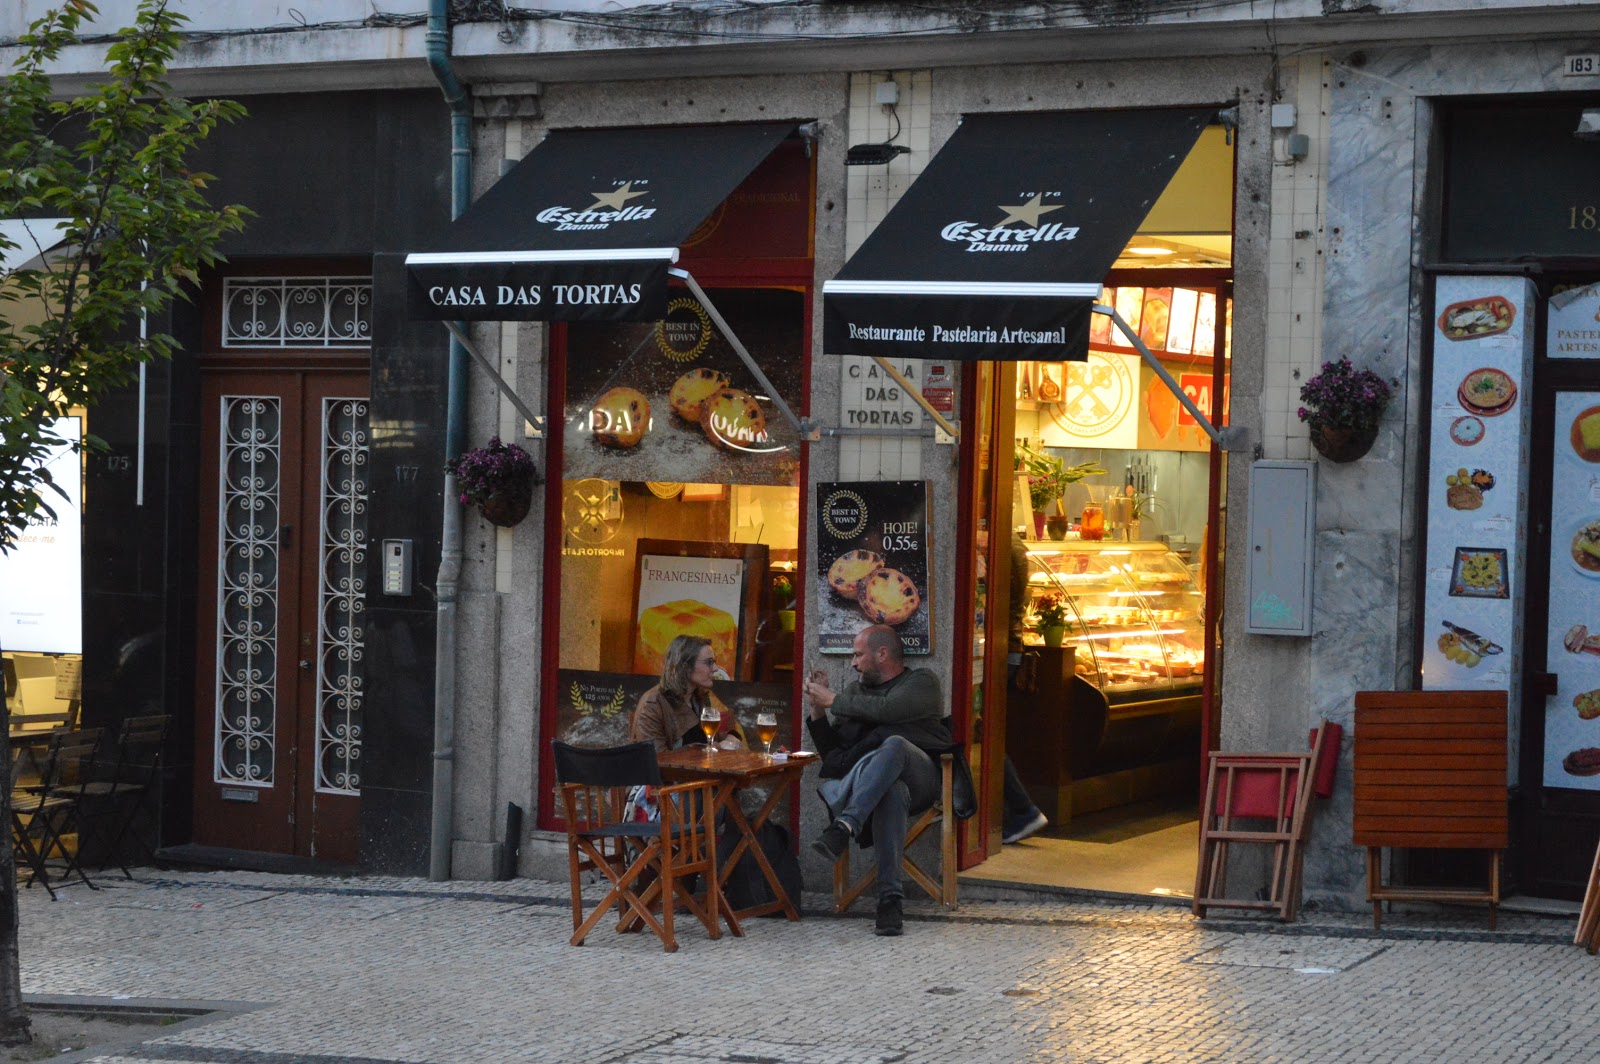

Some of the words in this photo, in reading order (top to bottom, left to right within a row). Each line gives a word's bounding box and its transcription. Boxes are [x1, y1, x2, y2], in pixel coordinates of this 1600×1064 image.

[1571, 58, 1592, 72] 183
[536, 205, 657, 224] Estrella
[1568, 205, 1600, 231] 18
[553, 222, 609, 232] Damm
[941, 220, 1080, 242] Estrella
[965, 242, 1029, 252] Damm
[429, 286, 486, 306] CASA
[496, 285, 541, 305] DAS
[552, 283, 641, 304] TORTAS
[665, 322, 688, 331] BEST
[690, 322, 701, 331] IN
[847, 322, 926, 342] Restaurante
[932, 325, 997, 343] Pastelaria
[999, 326, 1066, 344] Artesanal
[668, 333, 697, 342] TOWN
[866, 387, 899, 401] DAS
[848, 410, 914, 425] TORTAS
[108, 456, 130, 470] 175
[395, 466, 419, 481] 177
[831, 508, 850, 516] BEST
[850, 508, 859, 516] IN
[834, 516, 857, 524] TOWN
[883, 521, 918, 535] HOJE!
[882, 535, 919, 553] 0,55€
[648, 569, 736, 585] FRANCESINHAS
[900, 637, 920, 646] NOS
[585, 693, 596, 701] 125
